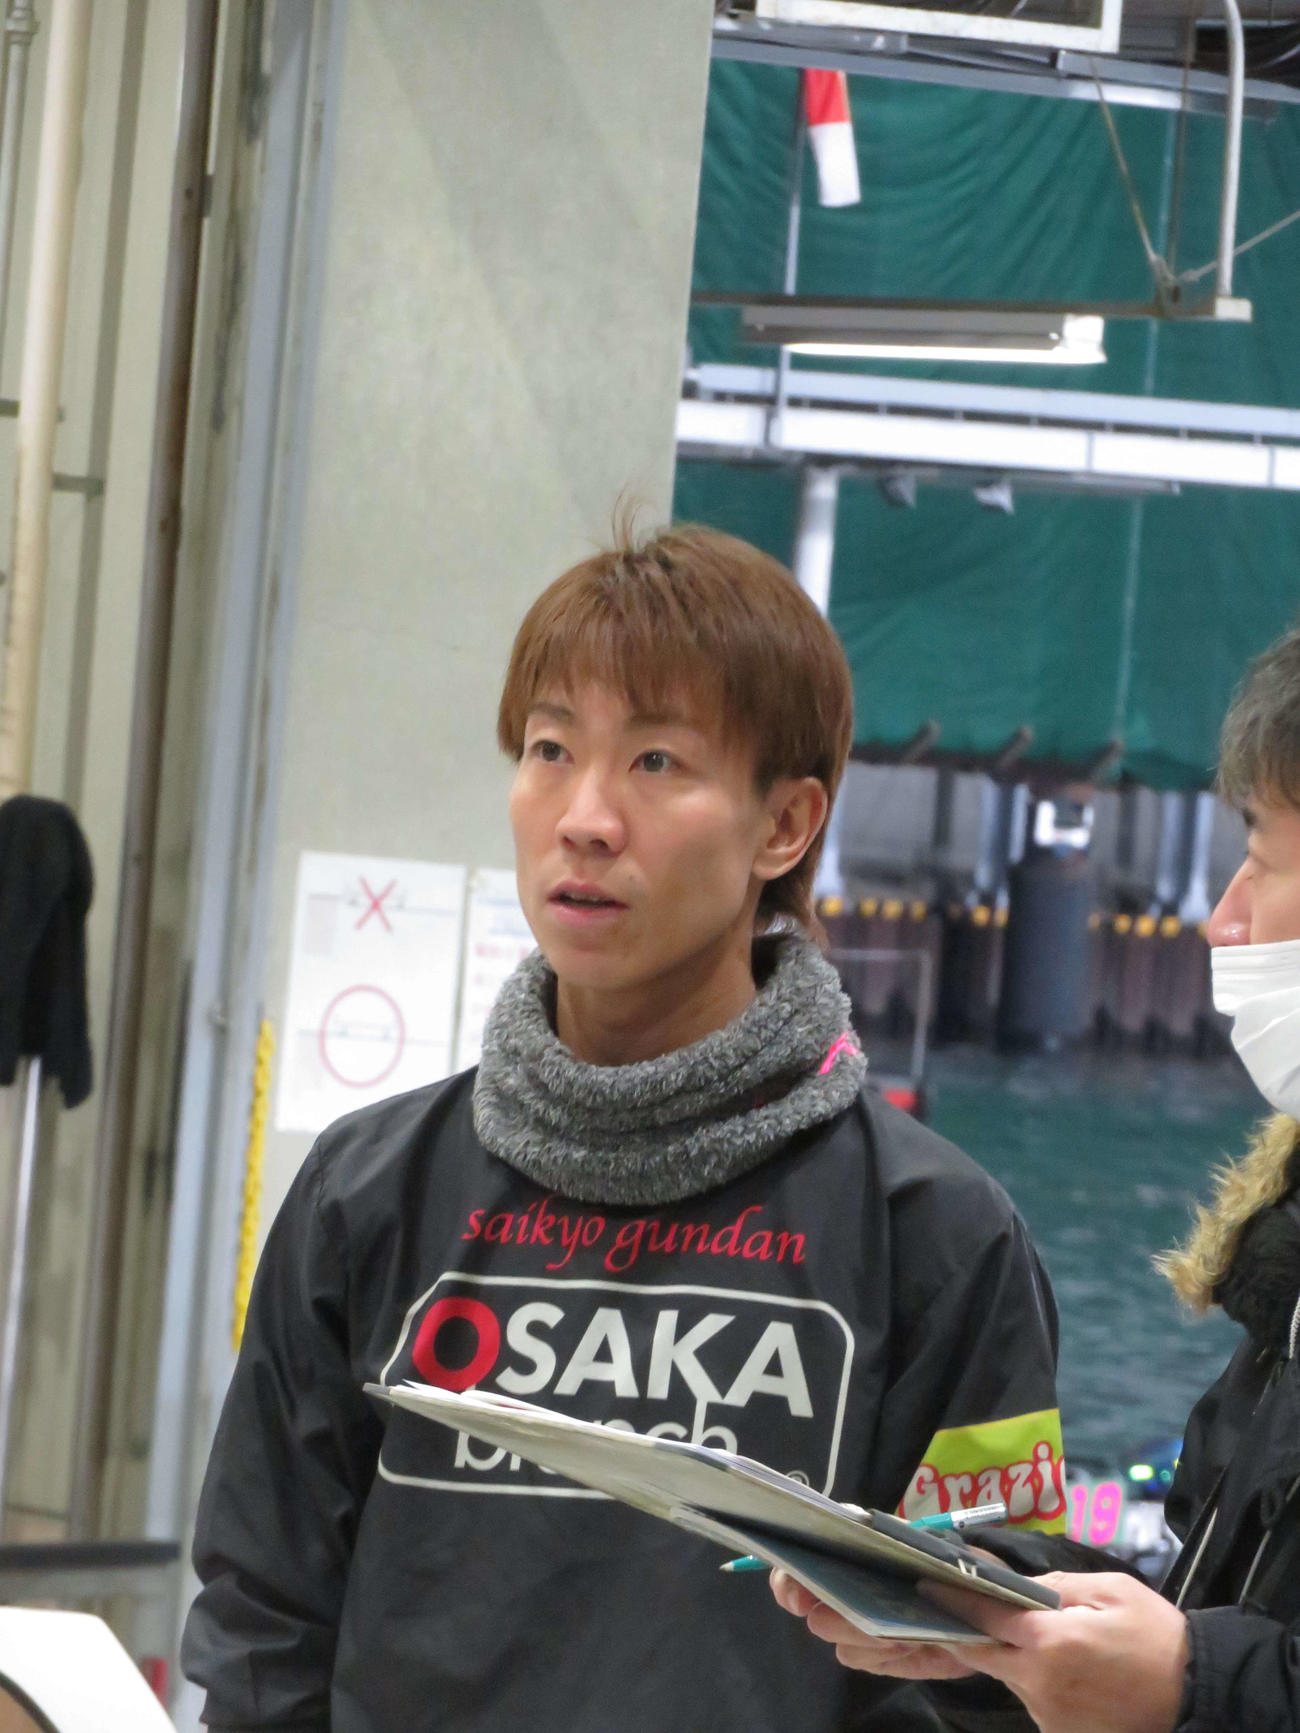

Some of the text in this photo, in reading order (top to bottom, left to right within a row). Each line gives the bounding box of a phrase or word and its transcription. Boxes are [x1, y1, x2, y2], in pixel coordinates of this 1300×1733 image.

[461, 1199, 806, 1273] saikyo gundan
[412, 1296, 815, 1418] OSAKA
[900, 1440, 1067, 1524] Grazi
[1070, 1481, 1123, 1546] 19
